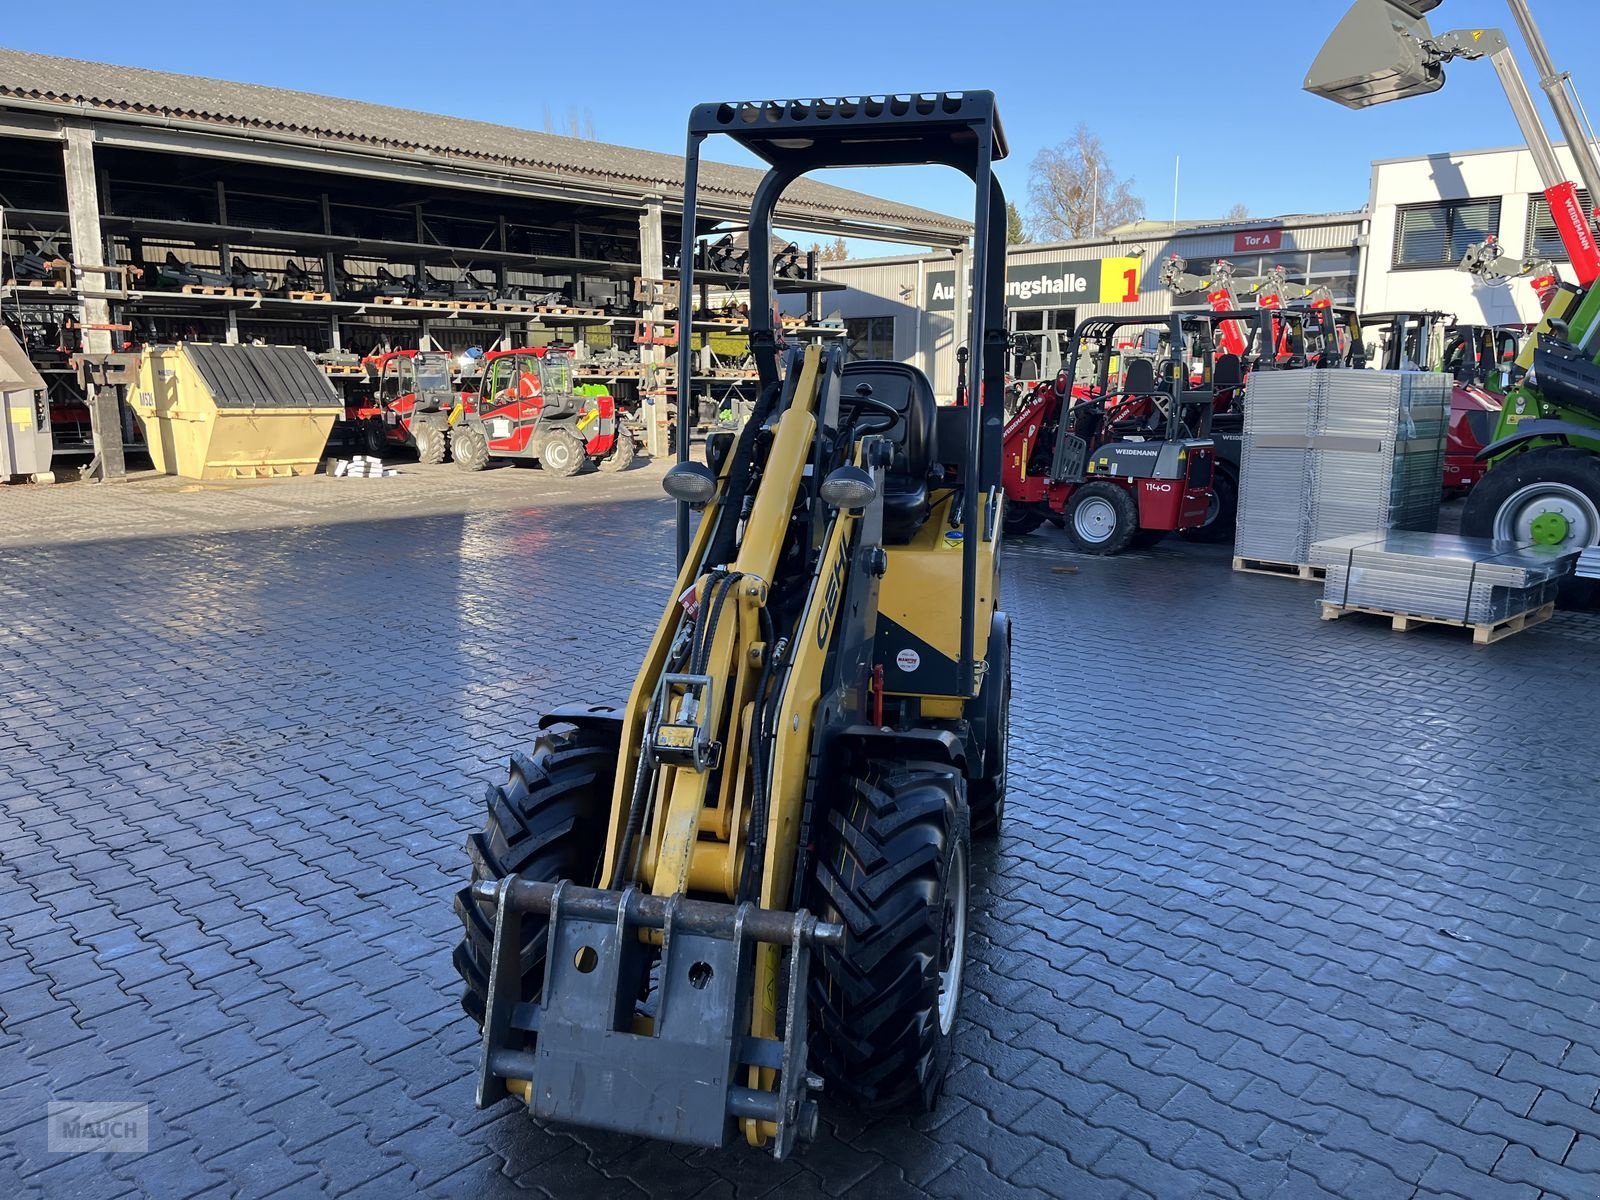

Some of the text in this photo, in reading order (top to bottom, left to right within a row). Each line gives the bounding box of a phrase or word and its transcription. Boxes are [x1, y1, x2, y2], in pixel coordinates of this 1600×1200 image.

[1564, 197, 1591, 250] WEIDEMANN
[1244, 234, 1271, 246] Tor A
[1122, 269, 1139, 302] 1
[1115, 448, 1158, 457] WEIDEMANN
[1145, 483, 1171, 492] 1140
